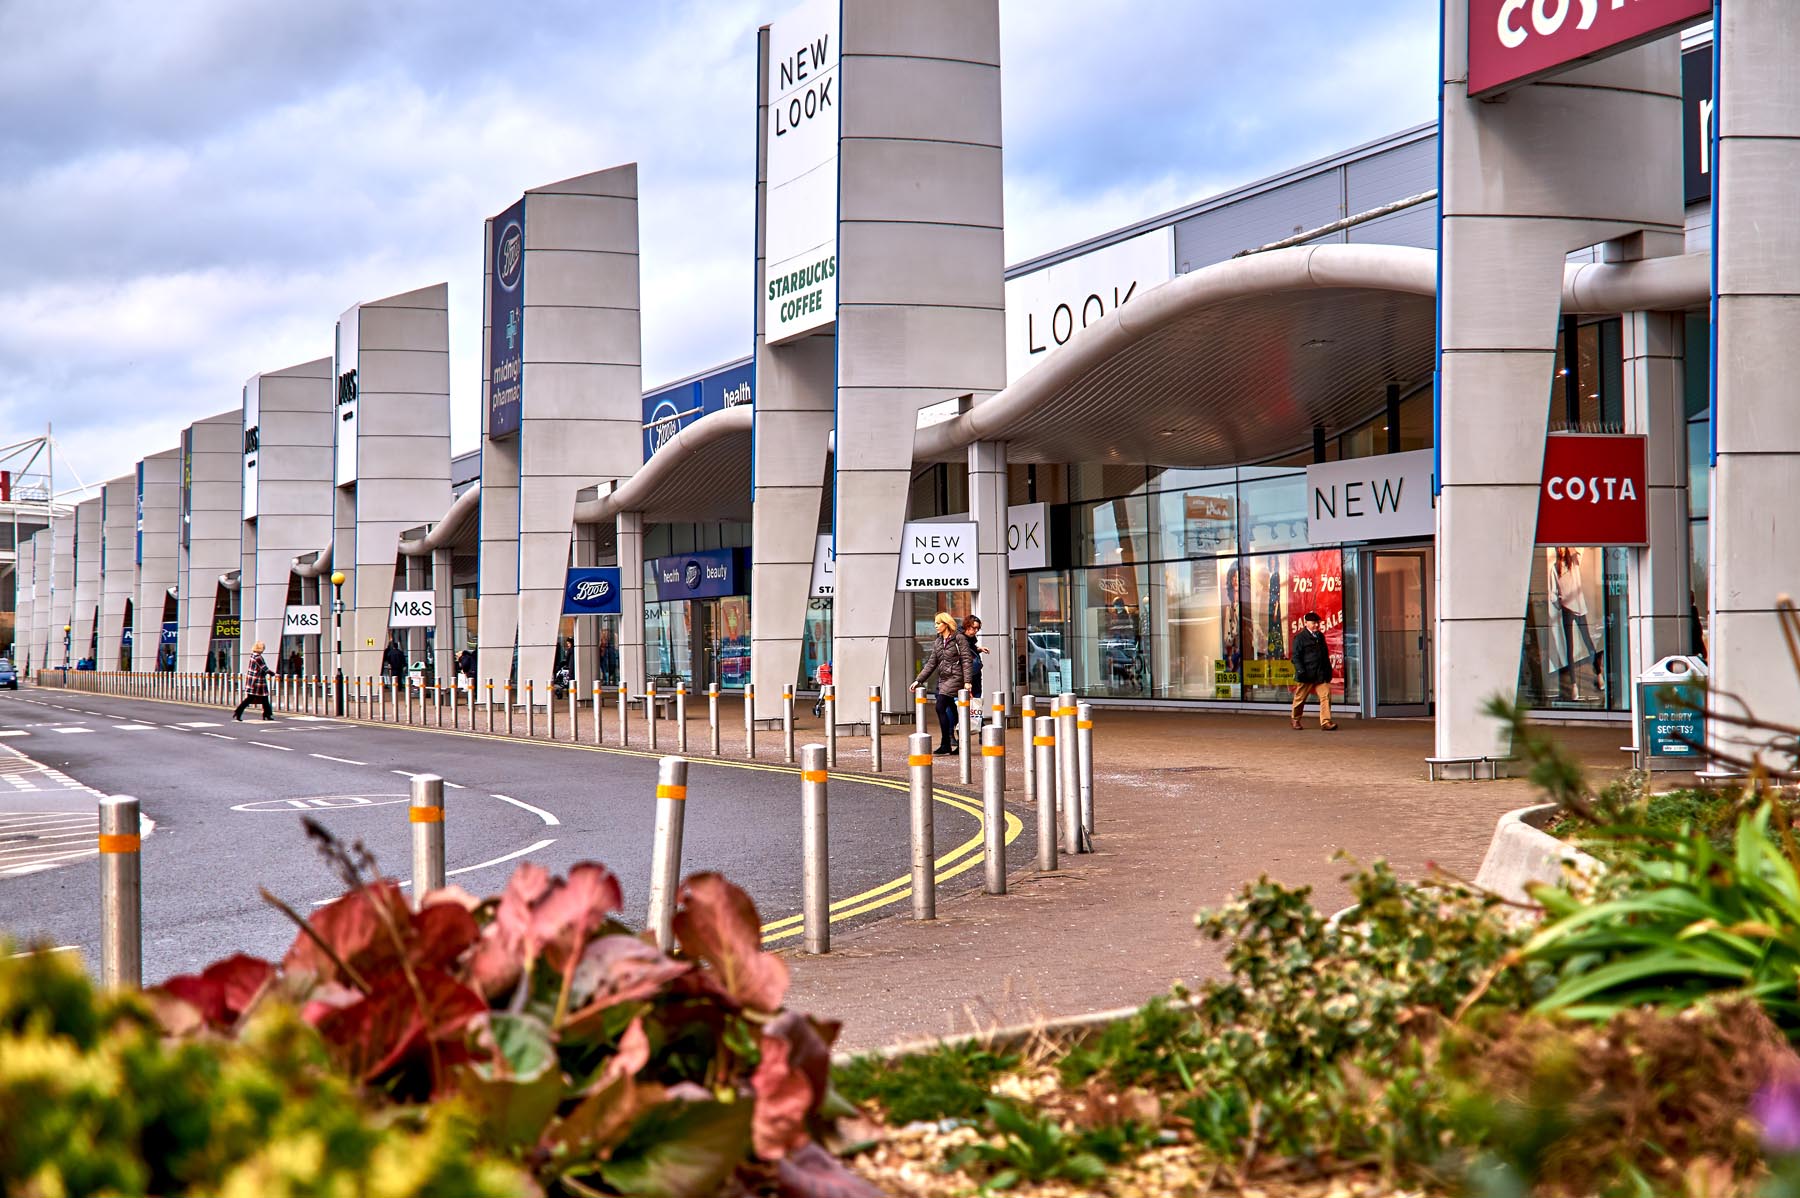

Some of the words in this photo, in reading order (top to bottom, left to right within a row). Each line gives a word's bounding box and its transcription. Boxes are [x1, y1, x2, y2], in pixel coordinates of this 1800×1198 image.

[781, 34, 828, 90] NEW
[776, 77, 832, 136] LOOK
[769, 255, 835, 301] STARBUCKS
[780, 289, 822, 323] COFFEE
[723, 381, 751, 409] health
[1315, 477, 1403, 520] NEW
[1547, 476, 1637, 504] COSTA
[916, 536, 960, 548] NEW
[1008, 521, 1039, 550] OK
[912, 552, 964, 564] LOOK
[706, 564, 727, 580] beauty
[906, 578, 969, 587] STARBUCKS
[573, 581, 609, 600] Boots
[287, 614, 319, 626] M&S
[393, 601, 432, 616] M&S
[217, 625, 240, 636] Pets
[1320, 610, 1344, 634] SALE
